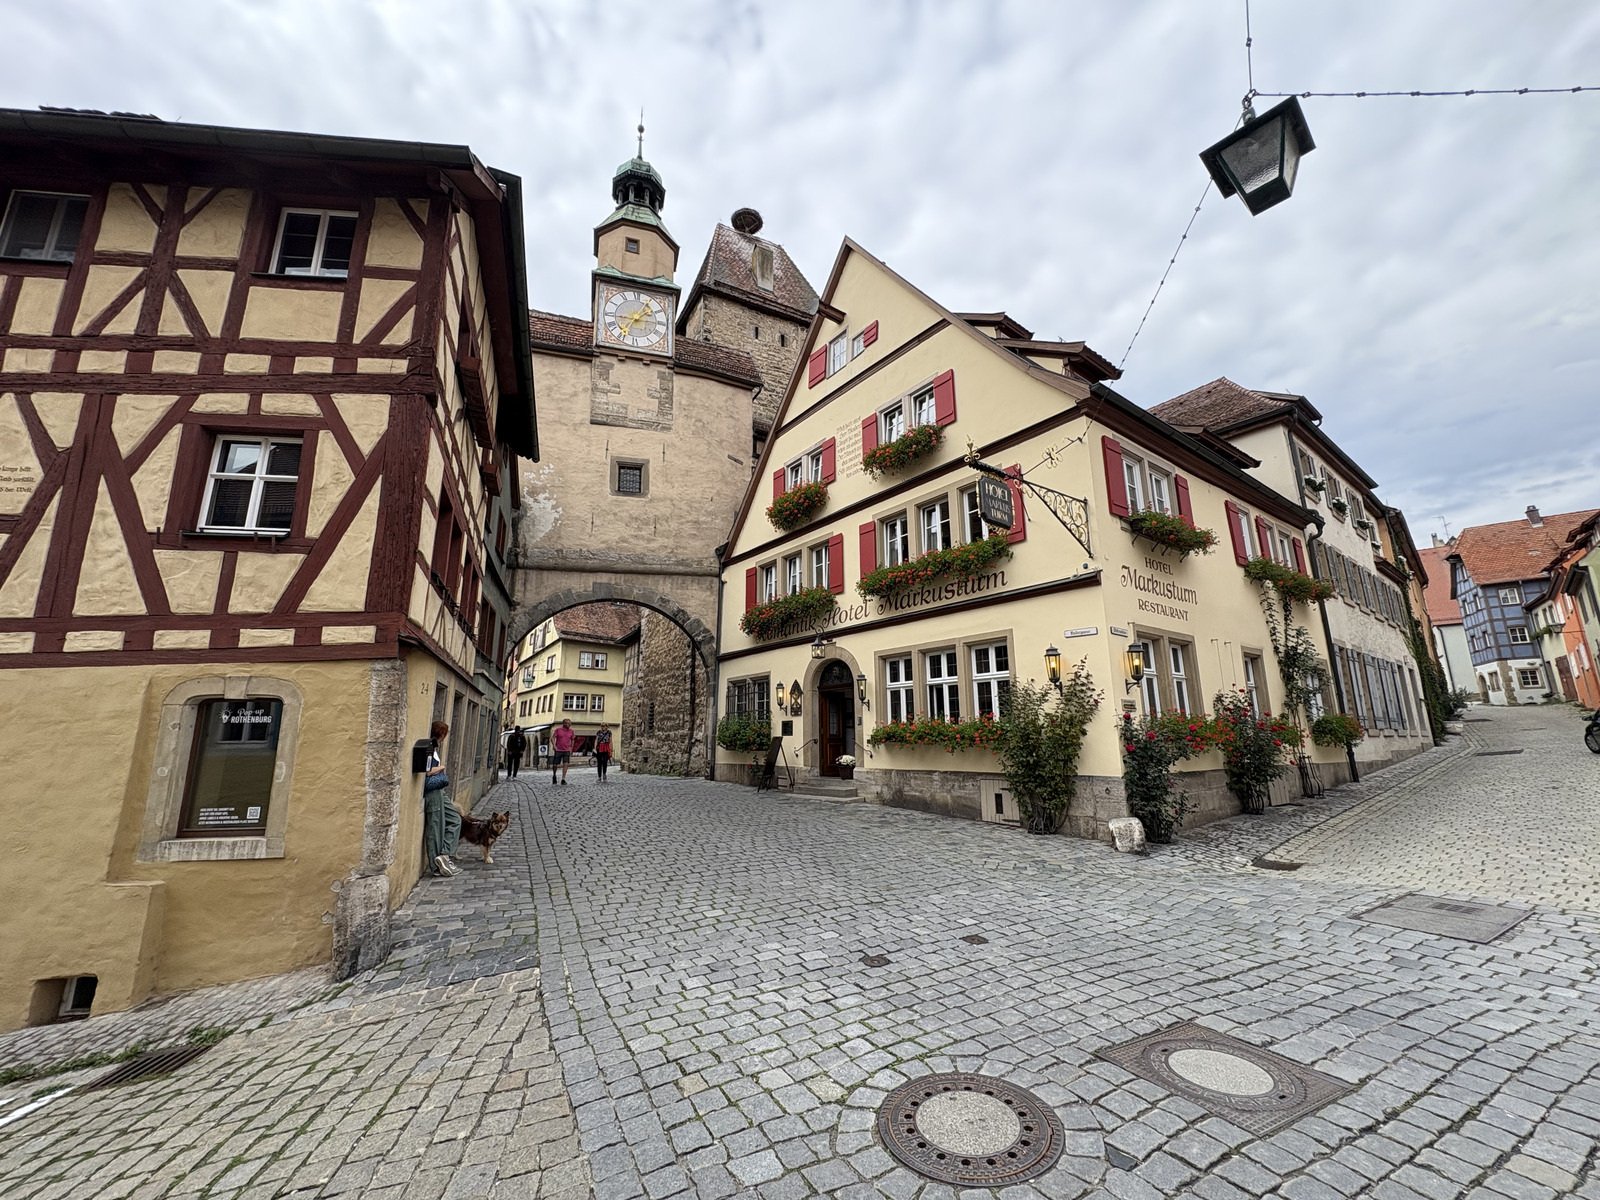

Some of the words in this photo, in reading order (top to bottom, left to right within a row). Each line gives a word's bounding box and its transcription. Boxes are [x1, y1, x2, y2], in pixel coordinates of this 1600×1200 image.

[985, 482, 1008, 501] HOTEL
[1144, 556, 1173, 575] HOTEL
[1120, 565, 1198, 605] Markusturm
[822, 602, 870, 629] Hotel
[877, 570, 1008, 616] Markusturm
[1138, 598, 1189, 621] RESTAURANT
[420, 682, 429, 695] 24
[230, 715, 272, 724] ROTHENBURG
